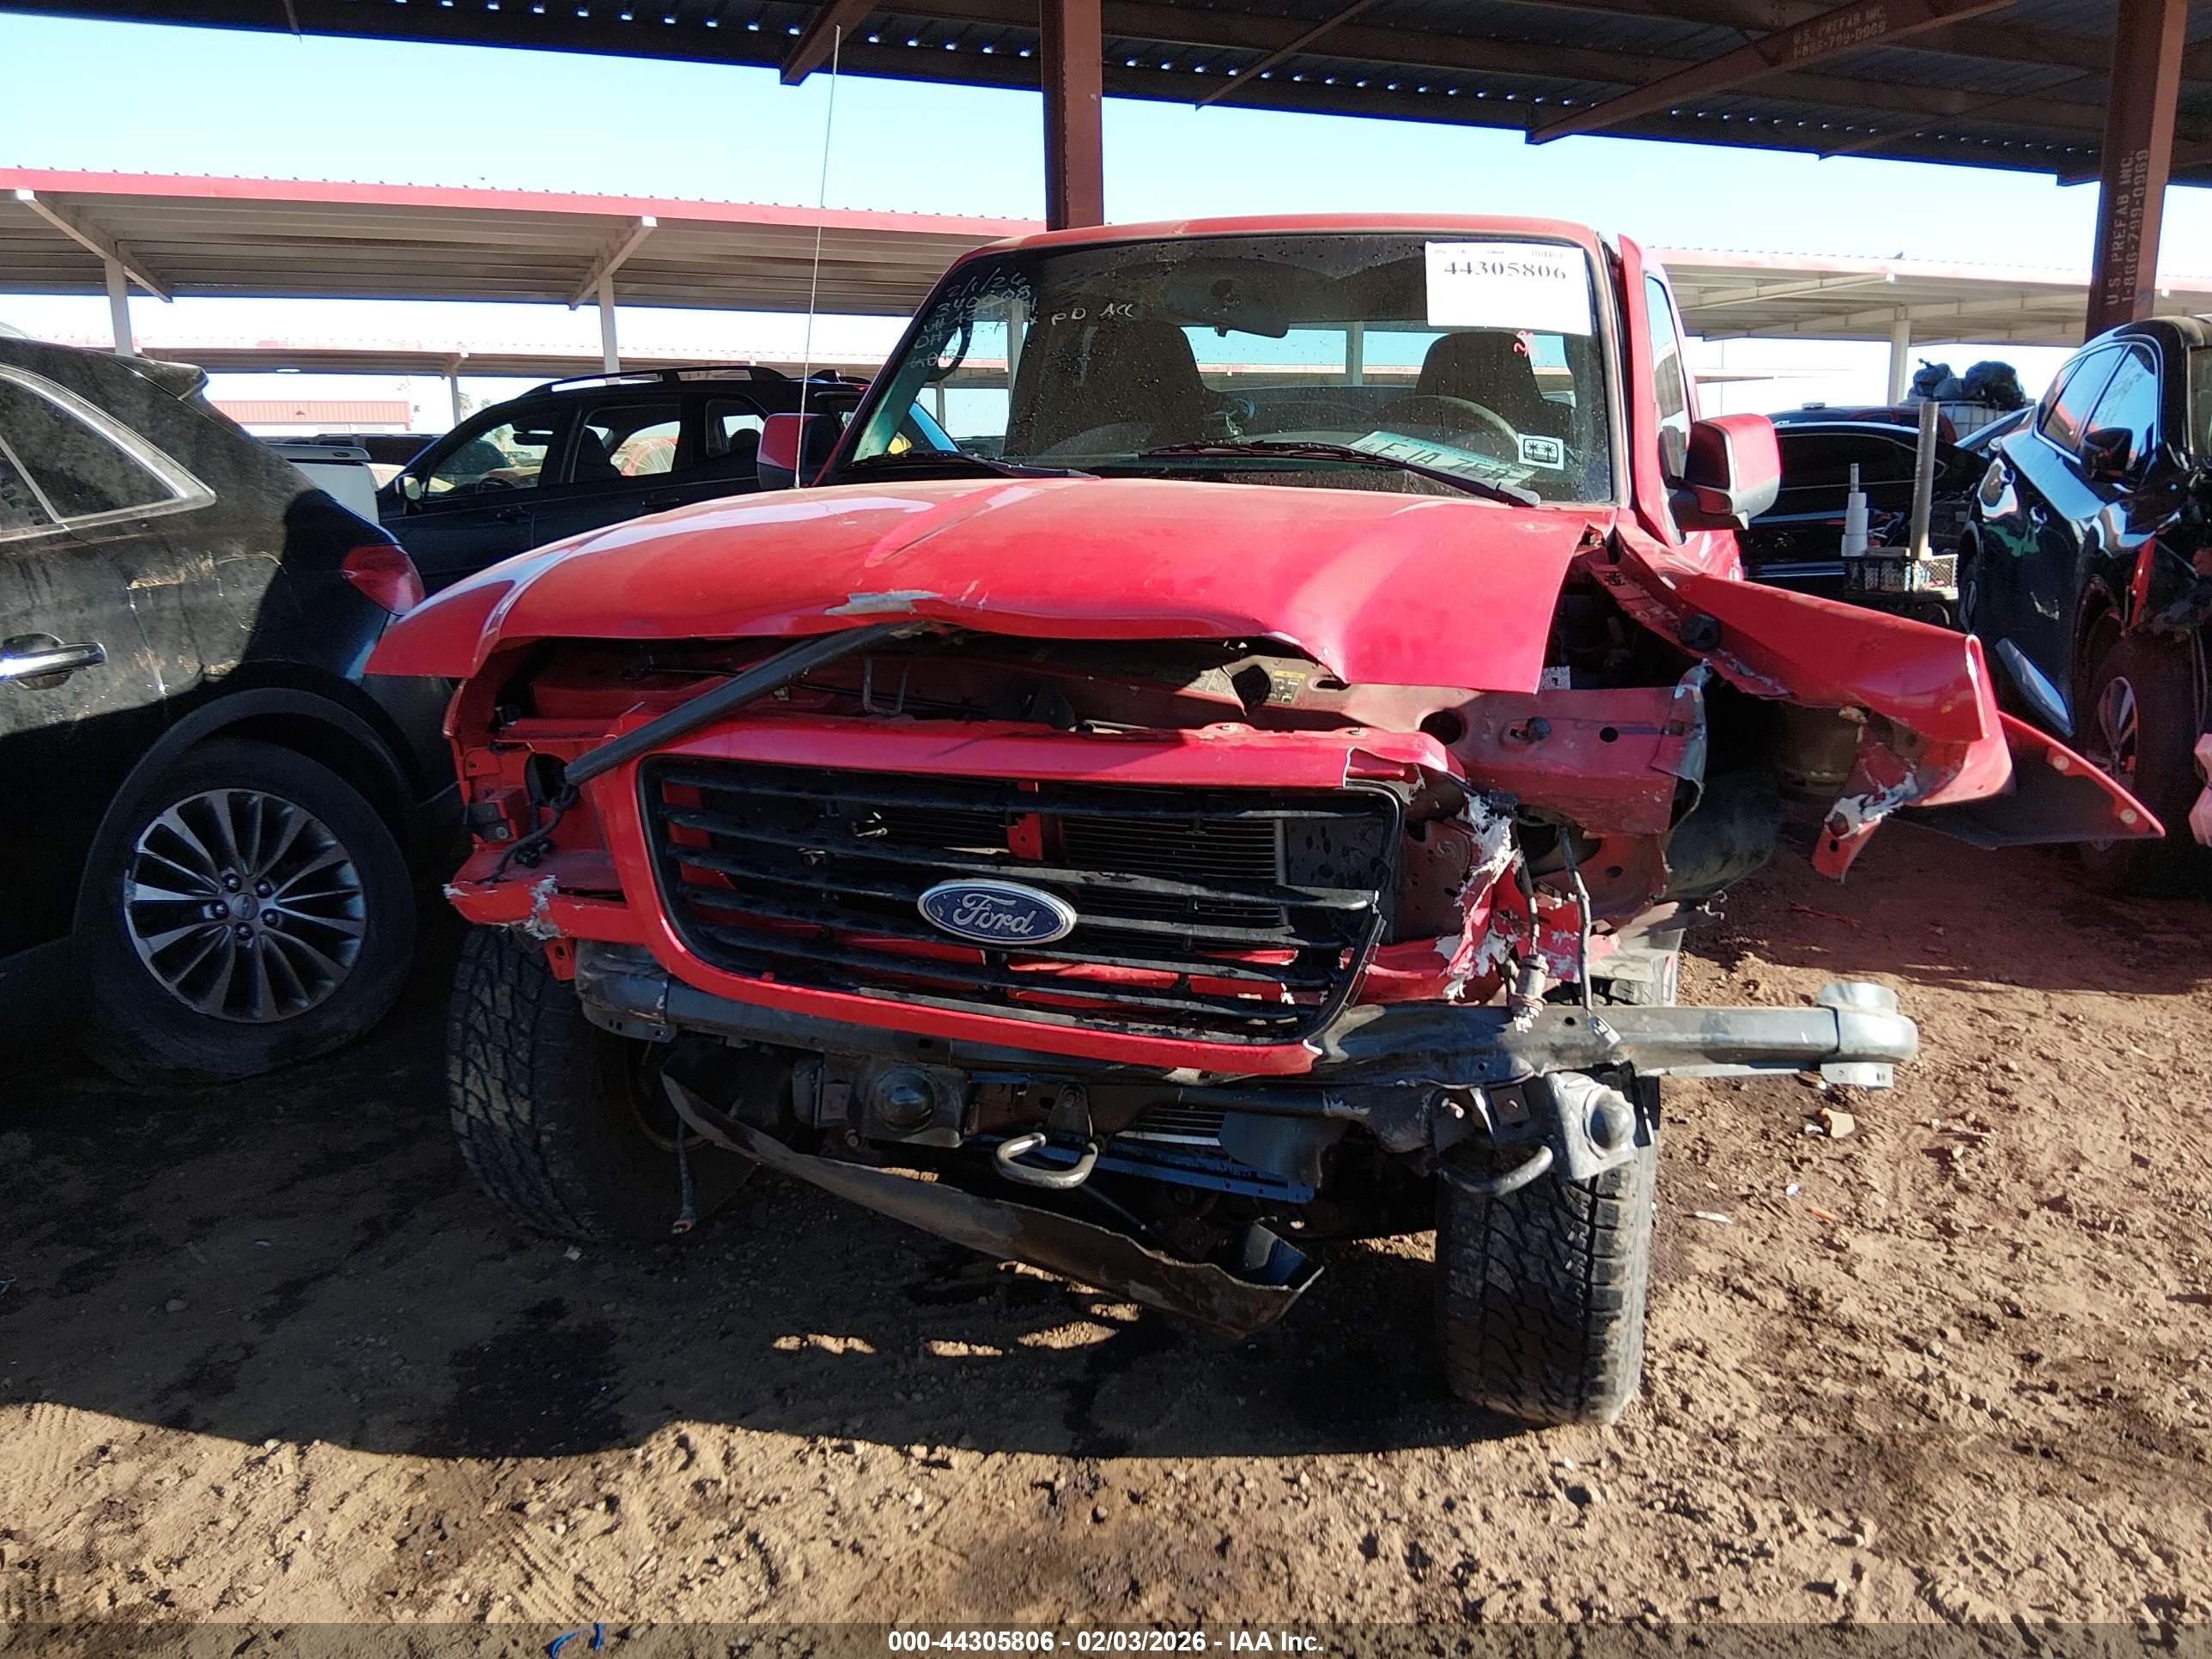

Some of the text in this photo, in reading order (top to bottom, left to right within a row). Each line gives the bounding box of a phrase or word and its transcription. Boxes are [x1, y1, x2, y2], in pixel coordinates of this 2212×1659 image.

[2112, 194, 2130, 262] PREFAB
[1444, 260, 1567, 281] 44305806
[952, 892, 1034, 935] Ford
